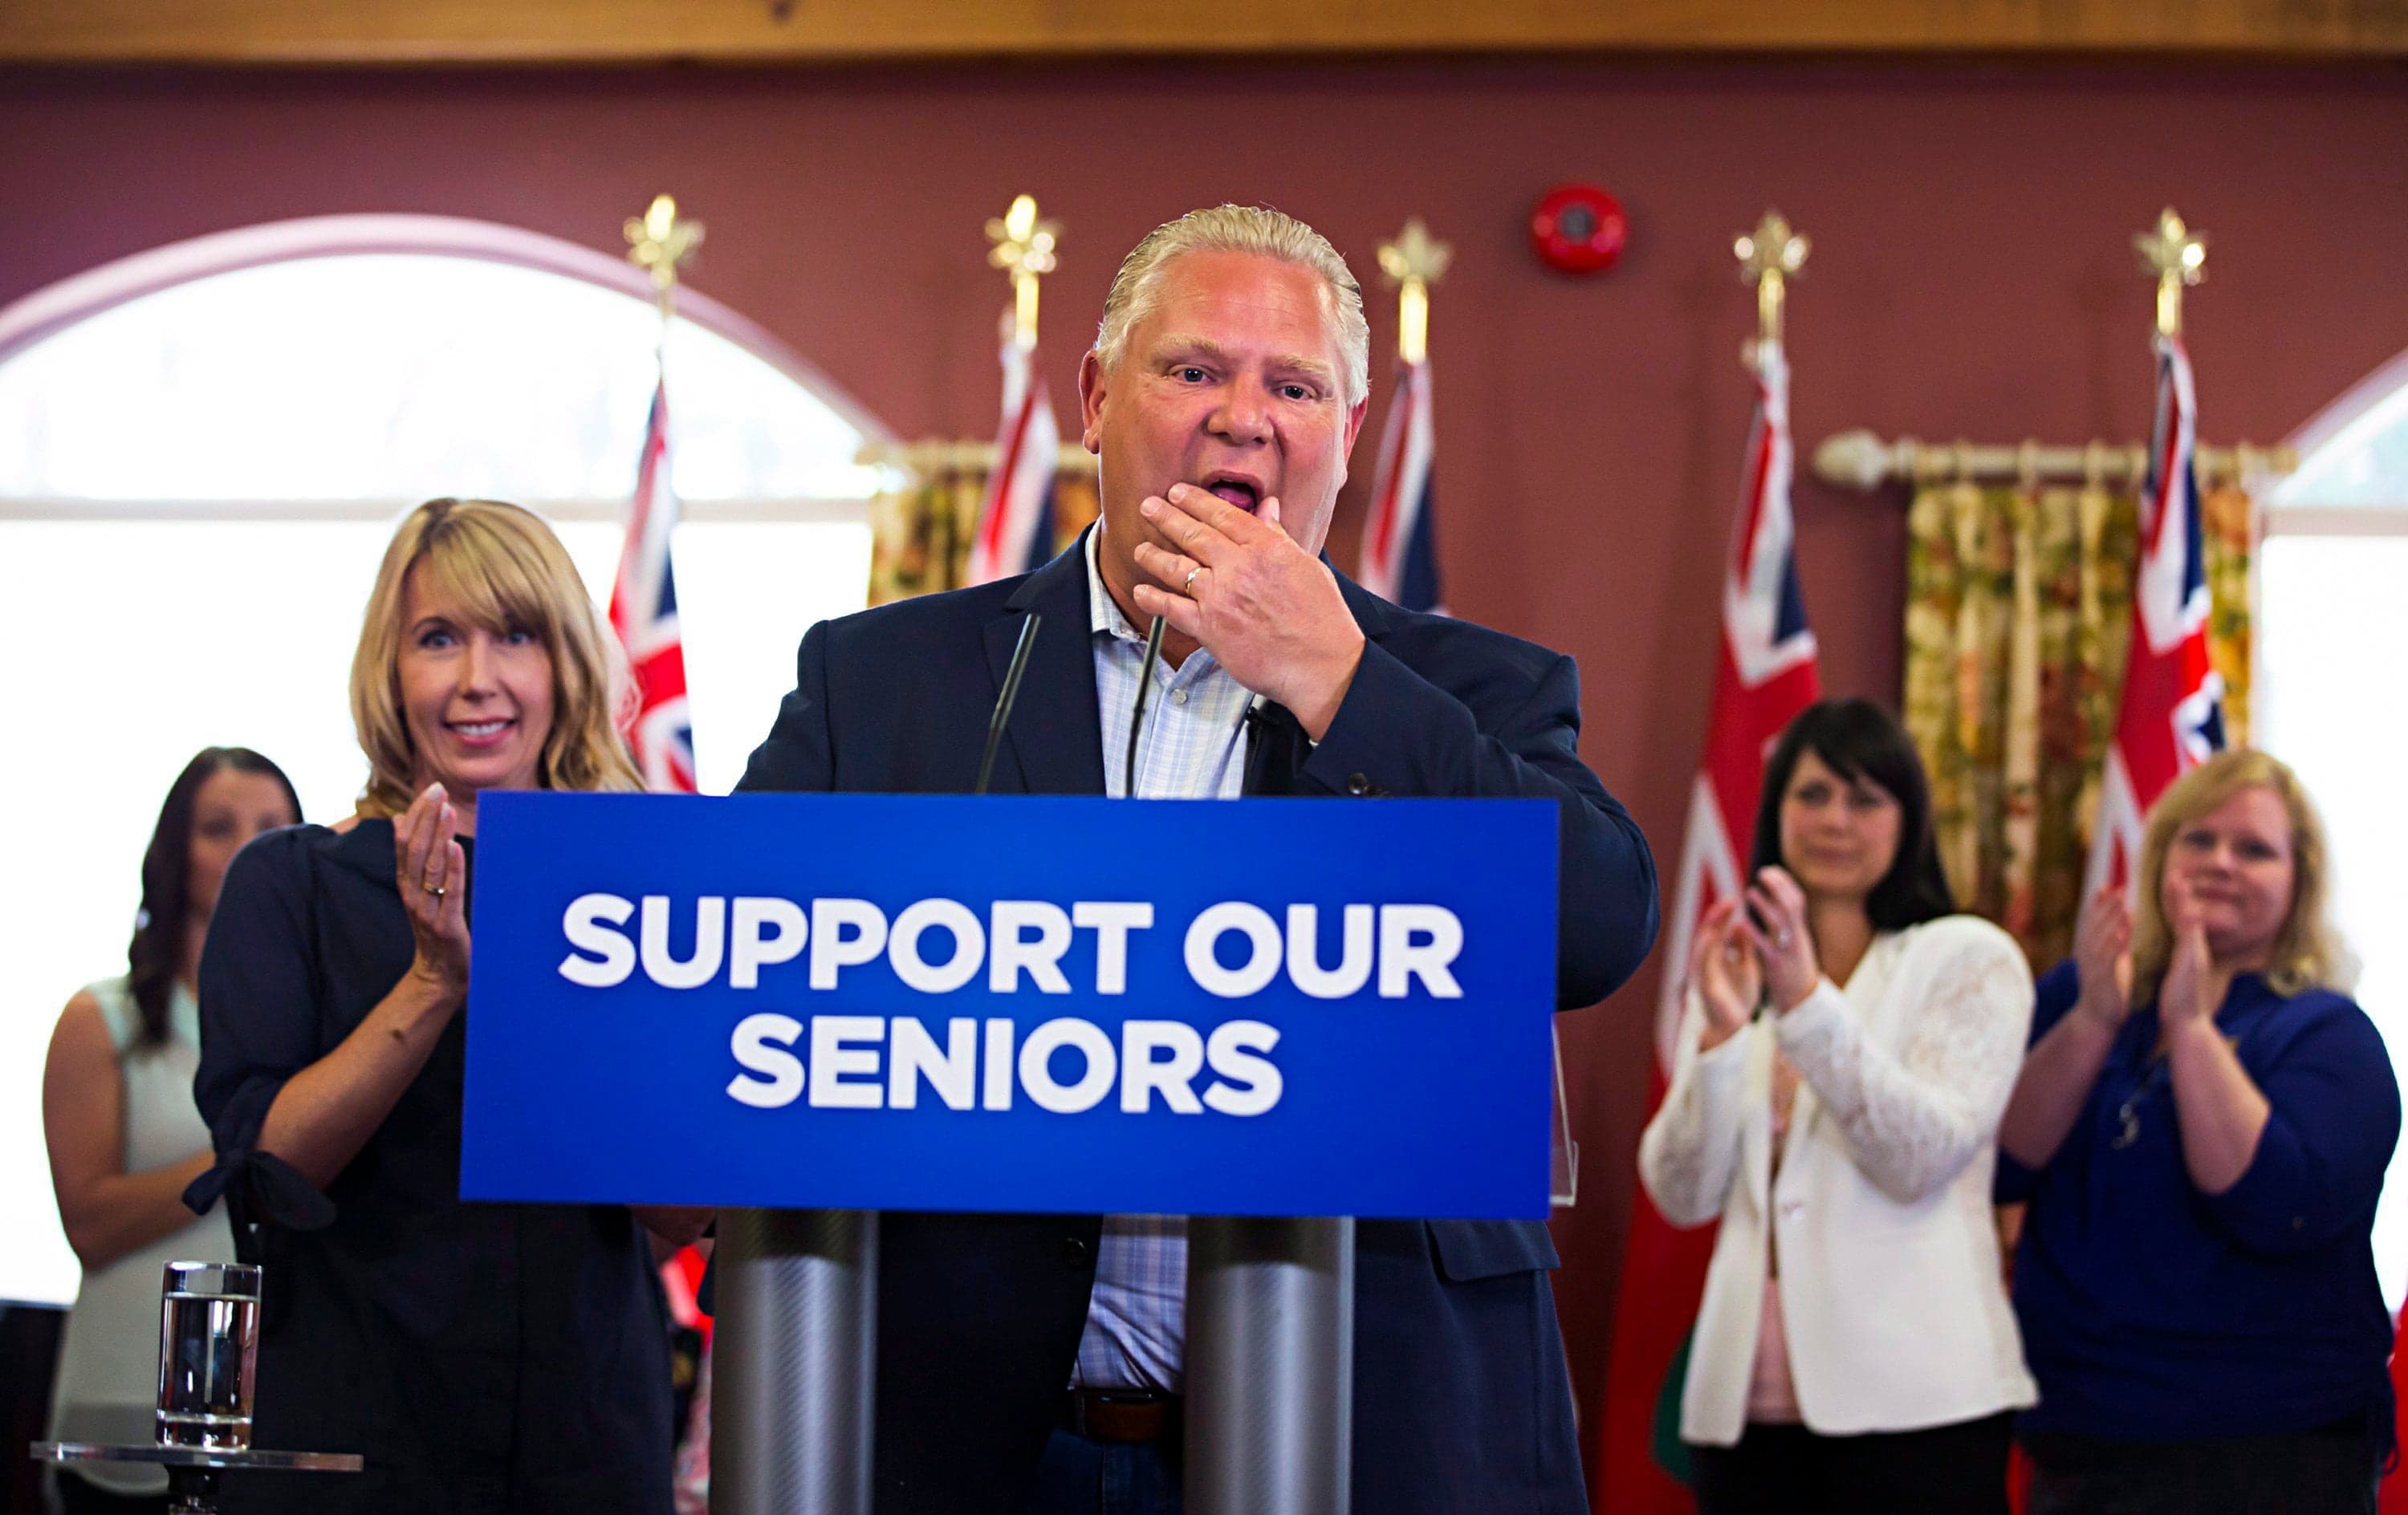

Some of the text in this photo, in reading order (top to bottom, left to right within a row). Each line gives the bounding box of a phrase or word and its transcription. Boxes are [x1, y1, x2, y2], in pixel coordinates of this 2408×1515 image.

[558, 894, 1463, 999] SUPPORT OUR
[726, 1013, 1283, 1116] SENIORS
